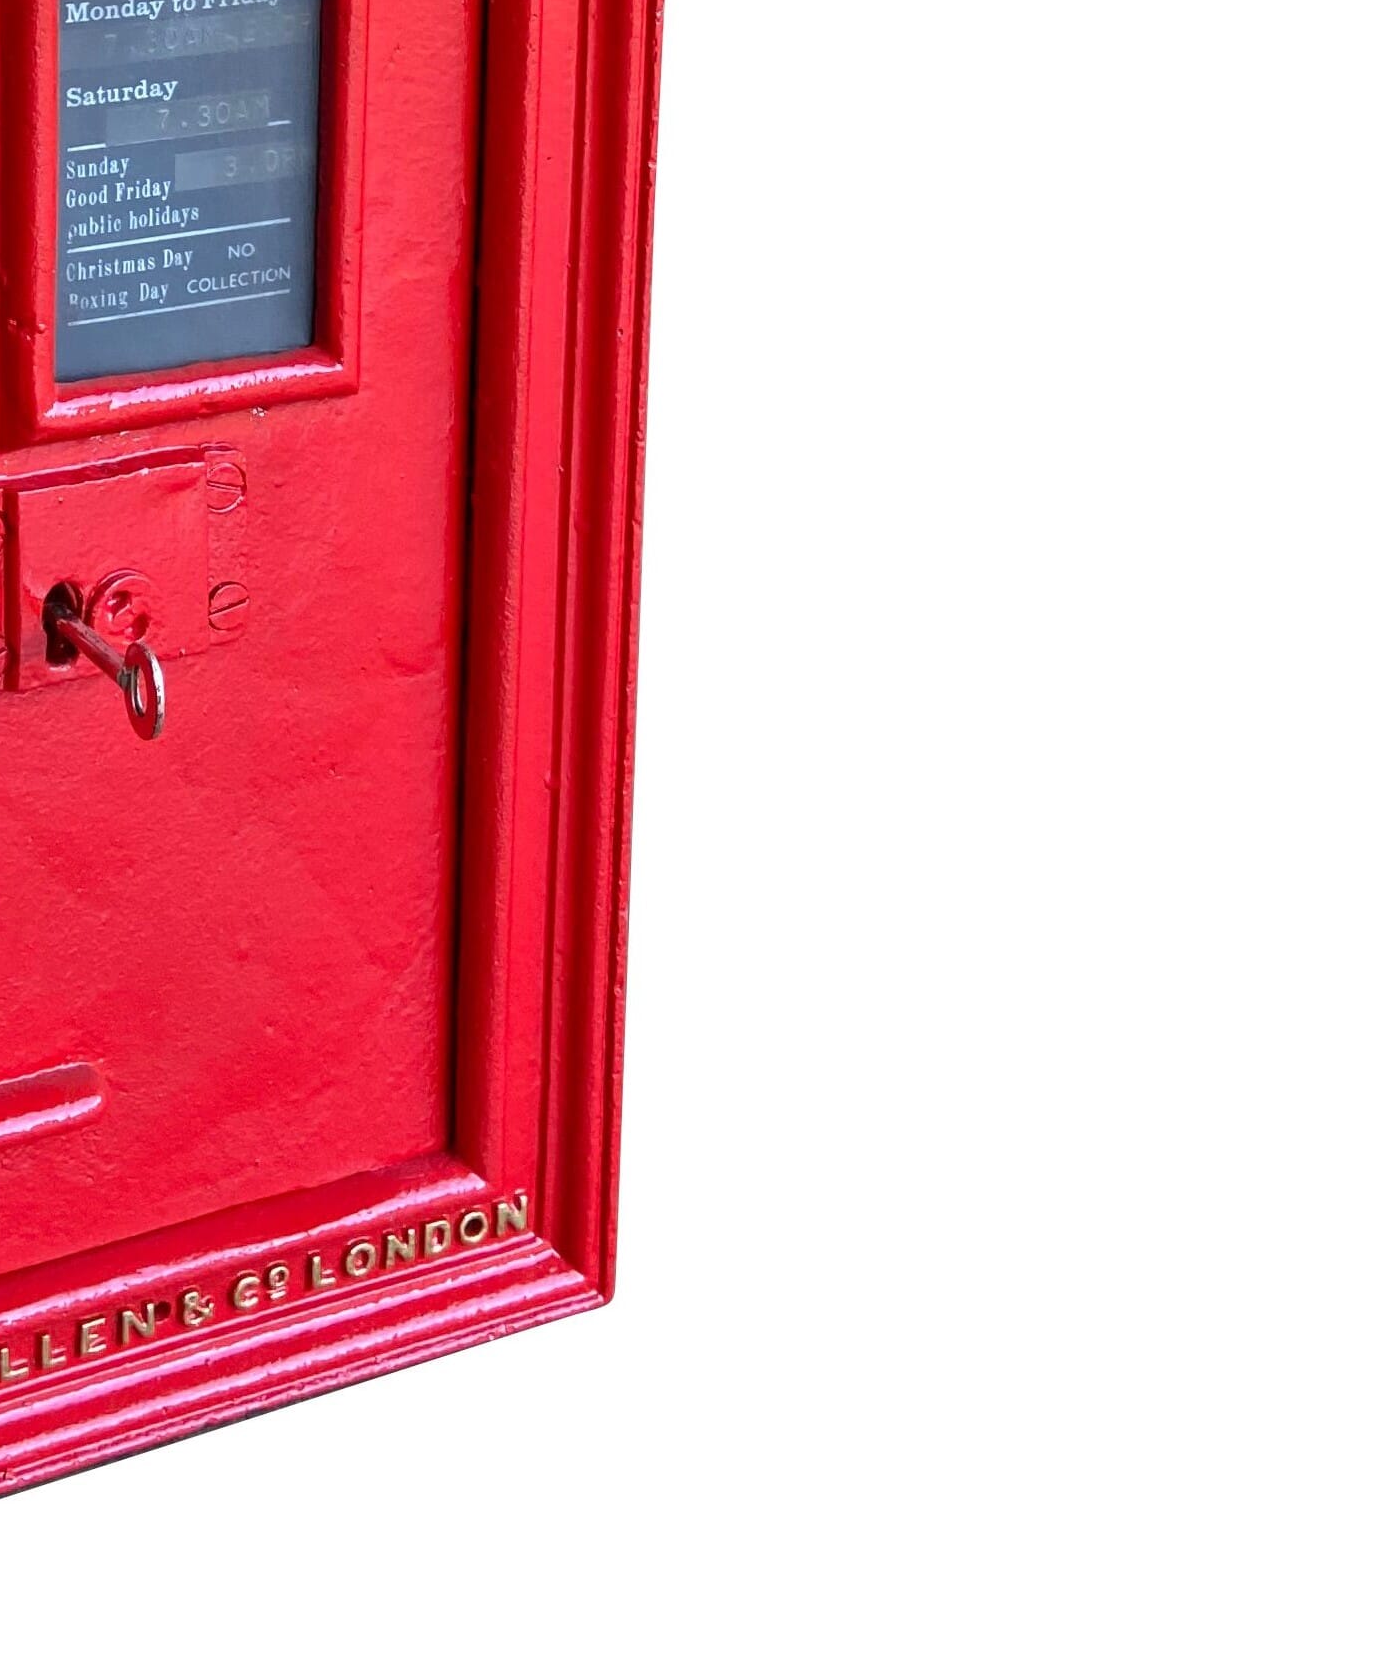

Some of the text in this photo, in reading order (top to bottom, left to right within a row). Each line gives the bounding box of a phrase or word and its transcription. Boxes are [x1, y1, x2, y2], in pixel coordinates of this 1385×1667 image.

[65, 79, 178, 109] Saturday
[66, 155, 130, 180] Sunday
[66, 179, 171, 209] Good Friday
[129, 205, 200, 228] holidays
[66, 243, 255, 283] Christmas Day NO
[139, 282, 169, 305] Day
[186, 265, 292, 295] COLLECTION
[181, 1288, 215, 1327] &
[310, 1191, 528, 1289] LONDON
